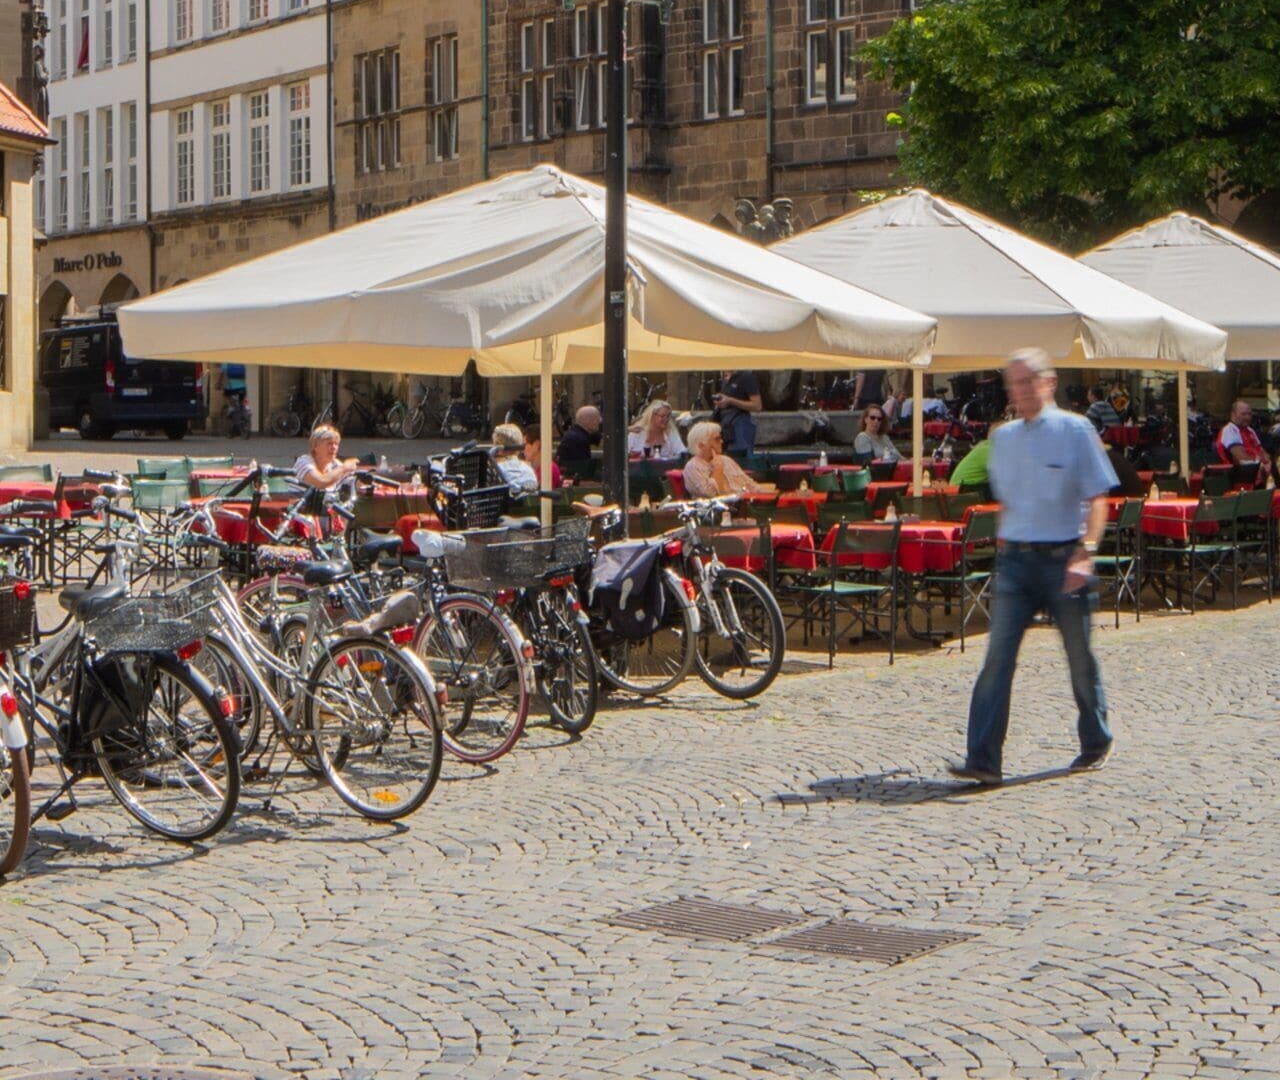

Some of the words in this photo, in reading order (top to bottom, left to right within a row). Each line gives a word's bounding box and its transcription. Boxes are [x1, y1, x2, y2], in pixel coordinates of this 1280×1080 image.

[53, 257, 83, 273] Marc
[83, 254, 95, 270] O
[96, 251, 123, 269] Polo
